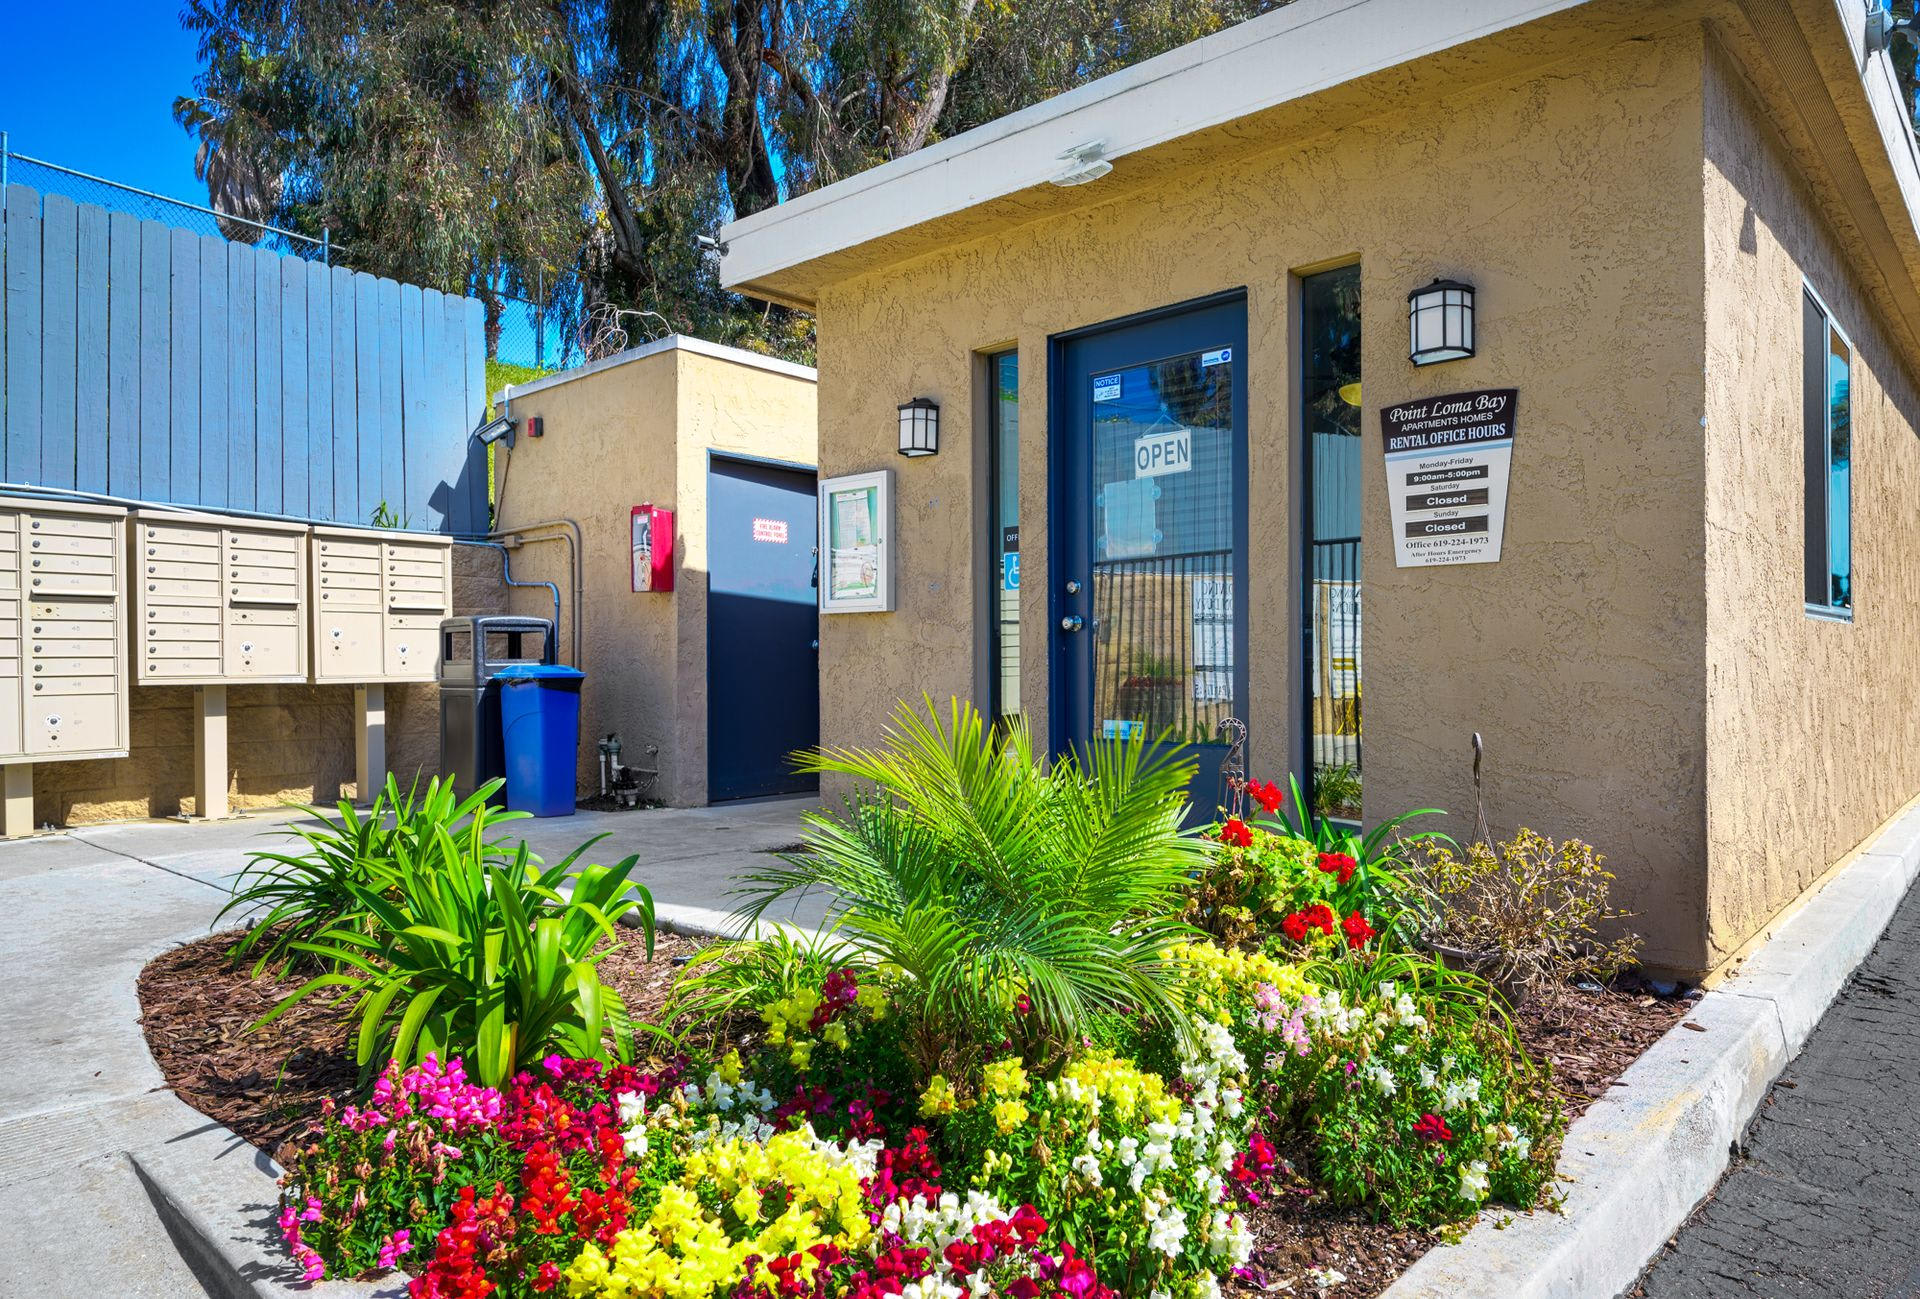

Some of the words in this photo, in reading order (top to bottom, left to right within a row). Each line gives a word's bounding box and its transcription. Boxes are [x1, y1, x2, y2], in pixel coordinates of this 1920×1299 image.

[1095, 376, 1119, 387] NOTICE
[1390, 408, 1427, 423] Point
[1431, 401, 1472, 417] Loma
[1475, 394, 1507, 413] Bay
[1401, 416, 1458, 432] APARTMENTS
[1461, 412, 1493, 423] HOMES
[1390, 435, 1428, 450] RENTAL
[1430, 429, 1466, 445] OFFICE
[1468, 423, 1506, 439] HOURS
[1137, 438, 1188, 471] OPEN
[1419, 456, 1474, 470] Monday-Friday
[1413, 469, 1481, 483] 9:00am-5:00pm
[1430, 482, 1460, 492] Saturday
[1426, 494, 1467, 506] Closed
[1433, 509, 1459, 518] Sunday
[1425, 521, 1466, 533] Closed
[1006, 533, 1019, 542] OFF
[1406, 540, 1432, 549] Office
[1433, 536, 1489, 547] 619-224-1973
[1427, 549, 1447, 557] Hours
[1447, 547, 1482, 556] Emergency
